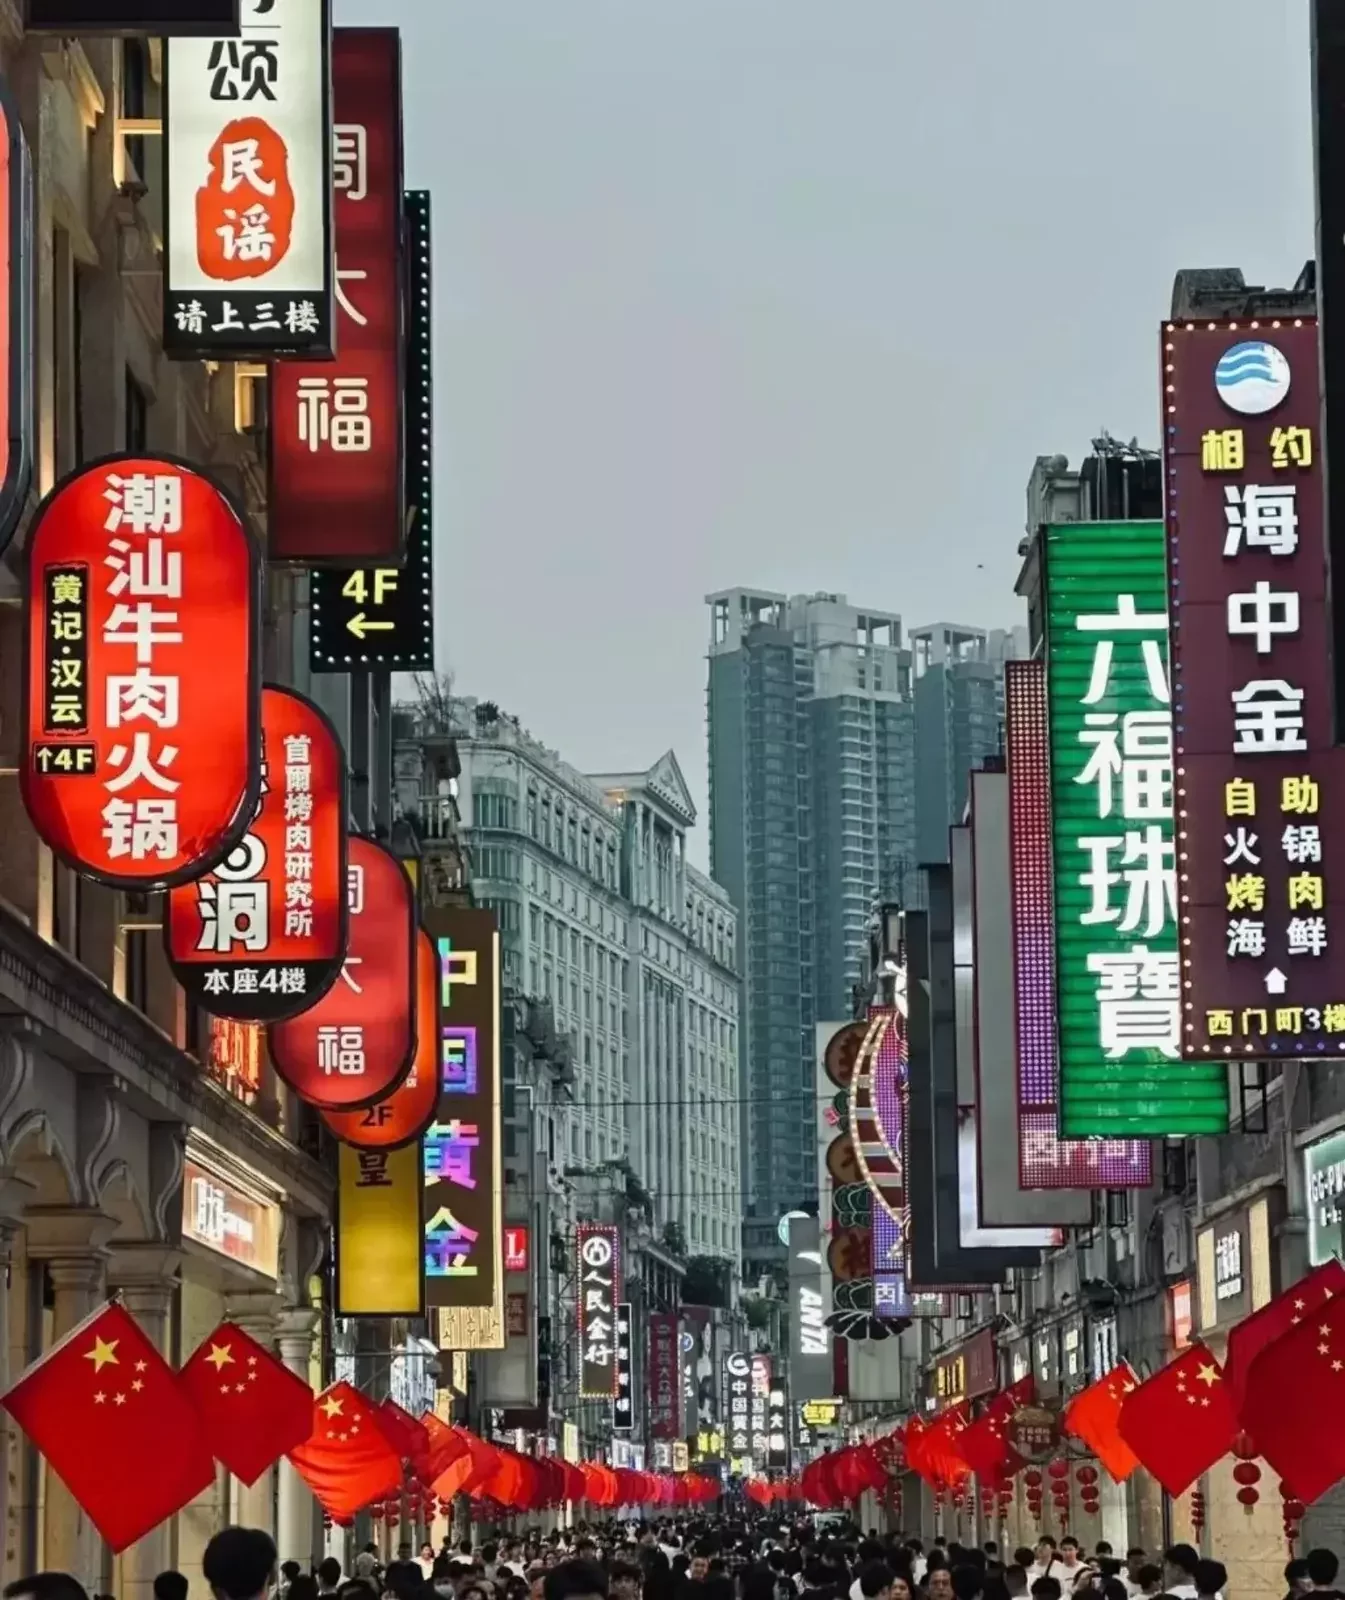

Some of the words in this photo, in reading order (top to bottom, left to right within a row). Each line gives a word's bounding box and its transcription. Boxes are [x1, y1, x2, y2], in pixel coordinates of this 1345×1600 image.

[215, 138, 276, 262] 民谣
[174, 300, 319, 335] 请上三楼
[1202, 426, 1311, 470] 相约
[342, 569, 398, 604] 4F
[1223, 484, 1307, 753] 海中金
[51, 575, 83, 723] 黄记·汉云
[102, 473, 183, 861] 潮汕牛肉火锅
[55, 748, 93, 771] 4F
[1225, 775, 1319, 817] 自助
[1073, 595, 1180, 1059] 六福珠寶
[1223, 825, 1322, 865] 火锅
[1225, 873, 1323, 912] 烤肉
[1226, 917, 1327, 958] 海鲜
[203, 967, 306, 997] 本座4楼
[360, 1105, 395, 1127] 2F
[799, 1286, 828, 1354] ANTA
